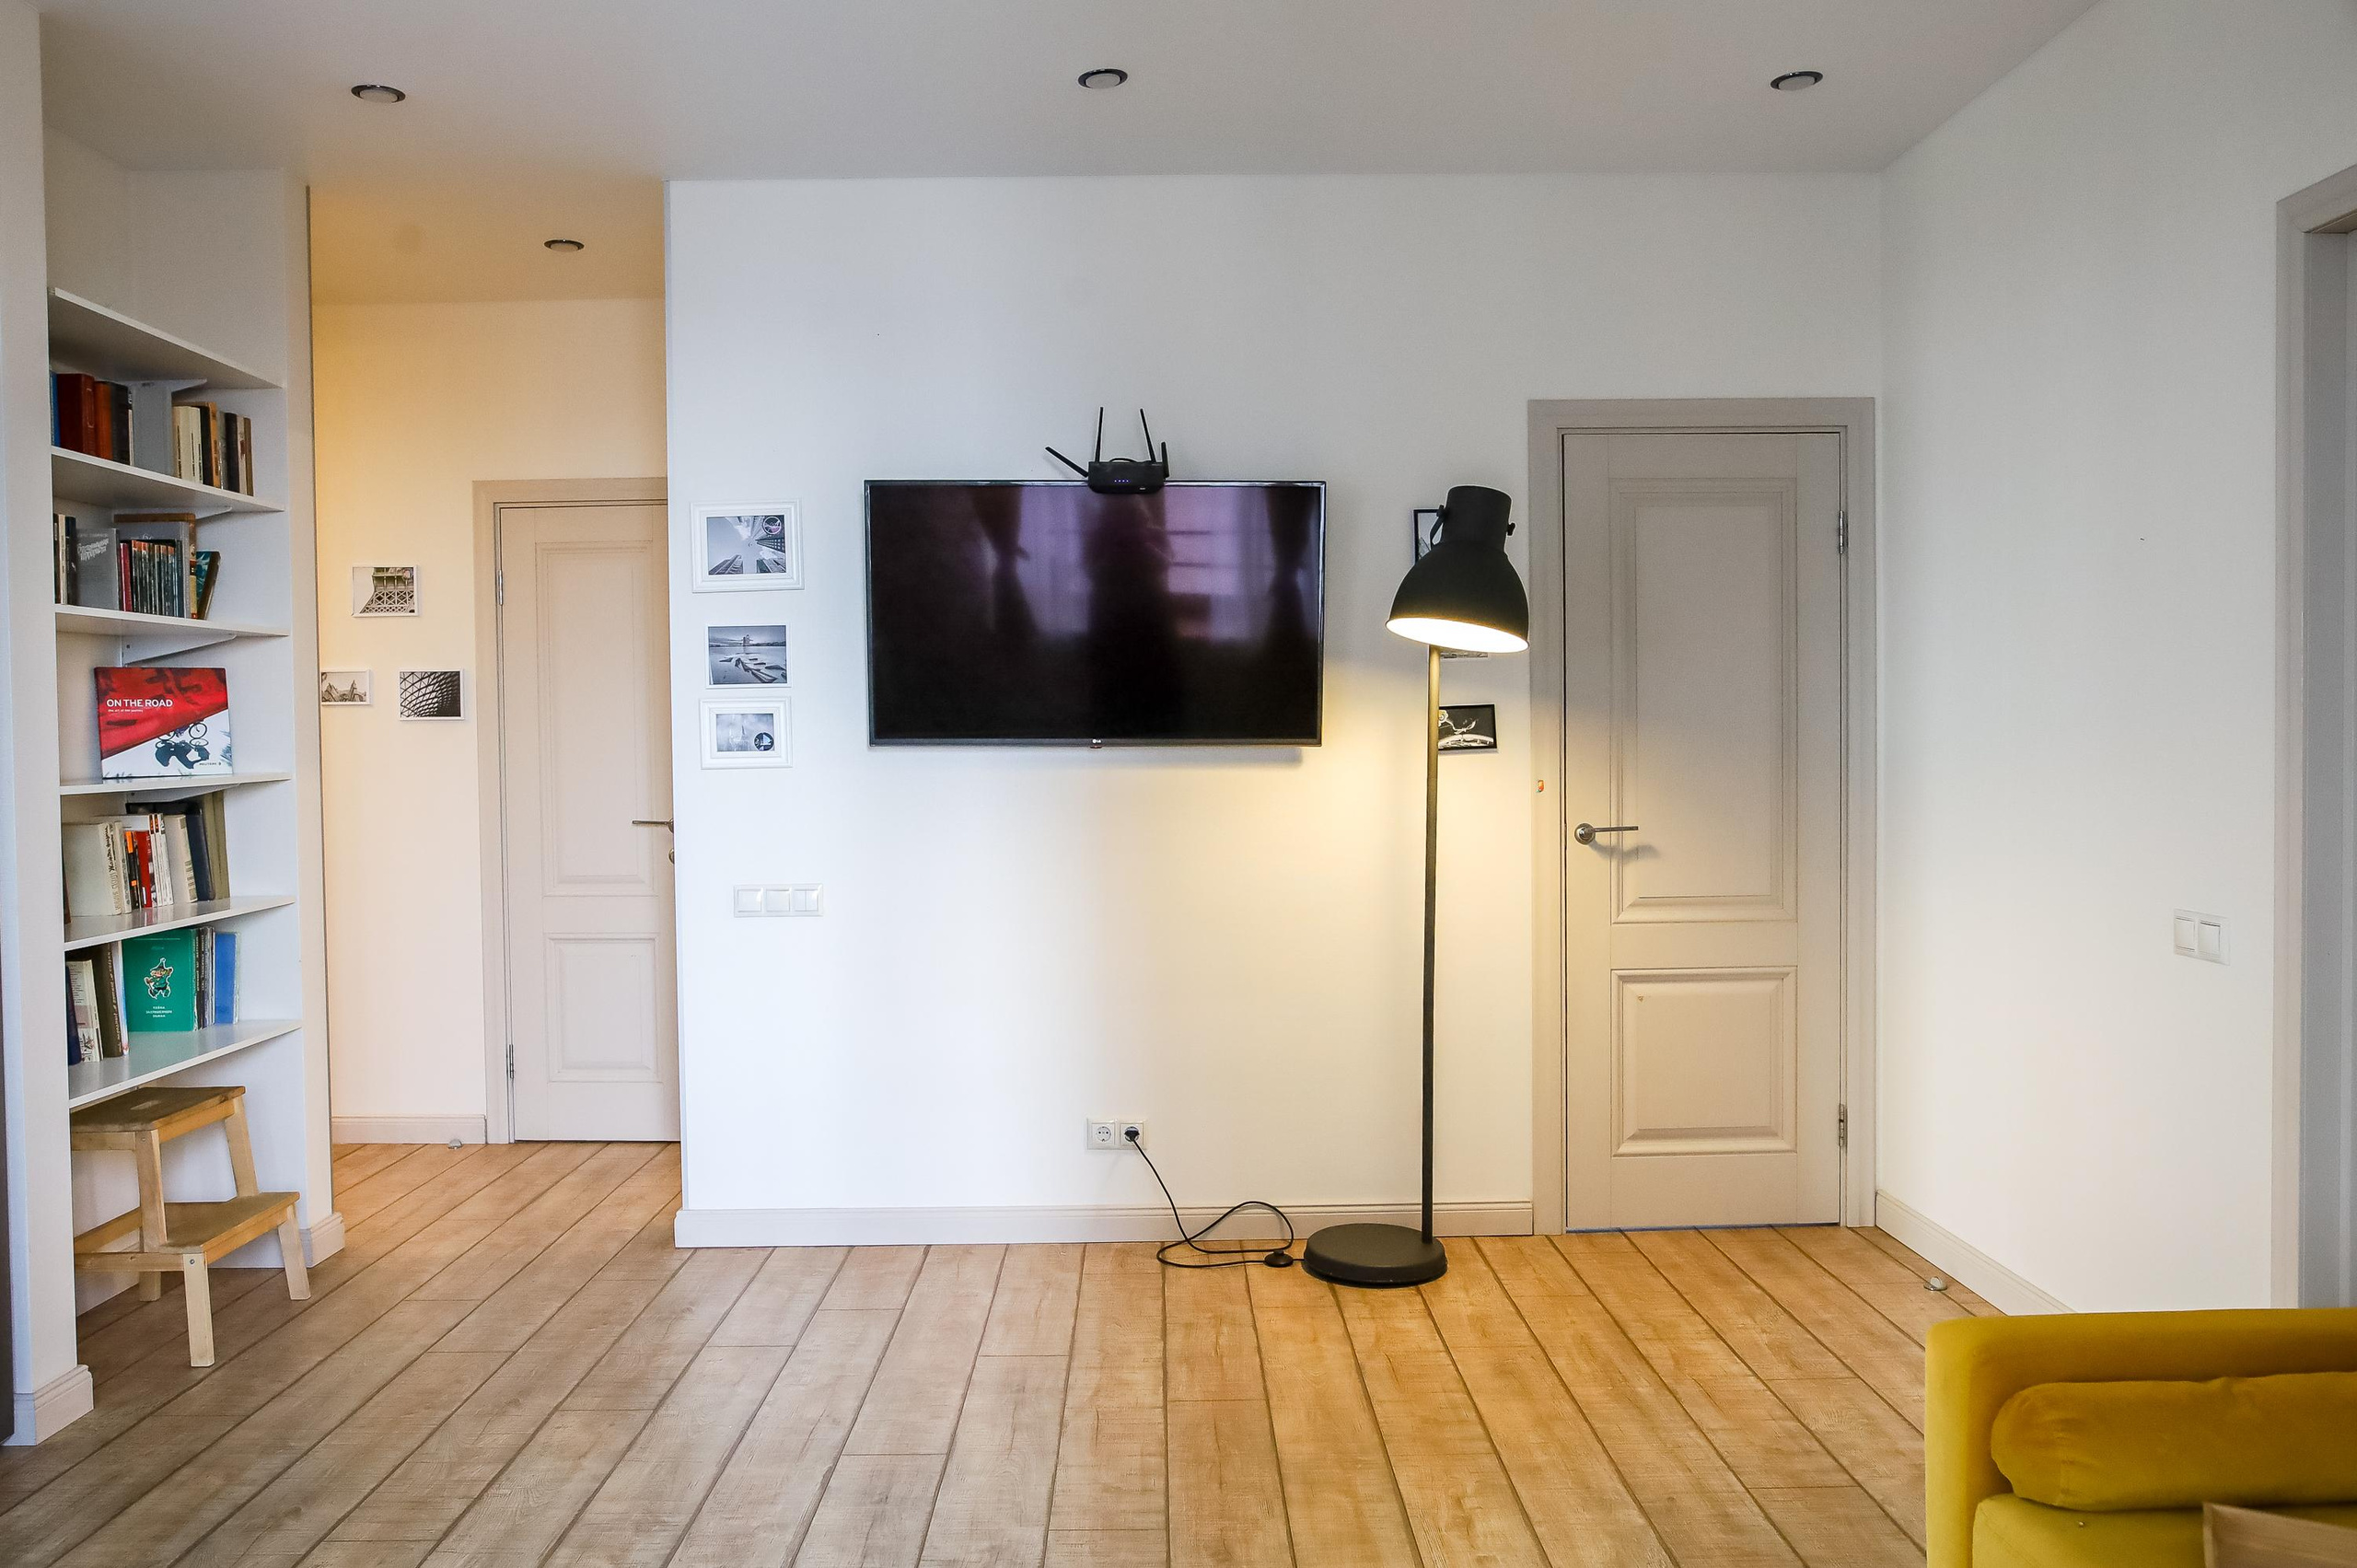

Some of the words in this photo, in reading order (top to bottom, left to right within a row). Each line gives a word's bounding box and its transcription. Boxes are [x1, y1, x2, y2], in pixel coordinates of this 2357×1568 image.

[106, 699, 122, 707] ON
[123, 699, 144, 707] THE
[145, 699, 173, 708] ROAD
